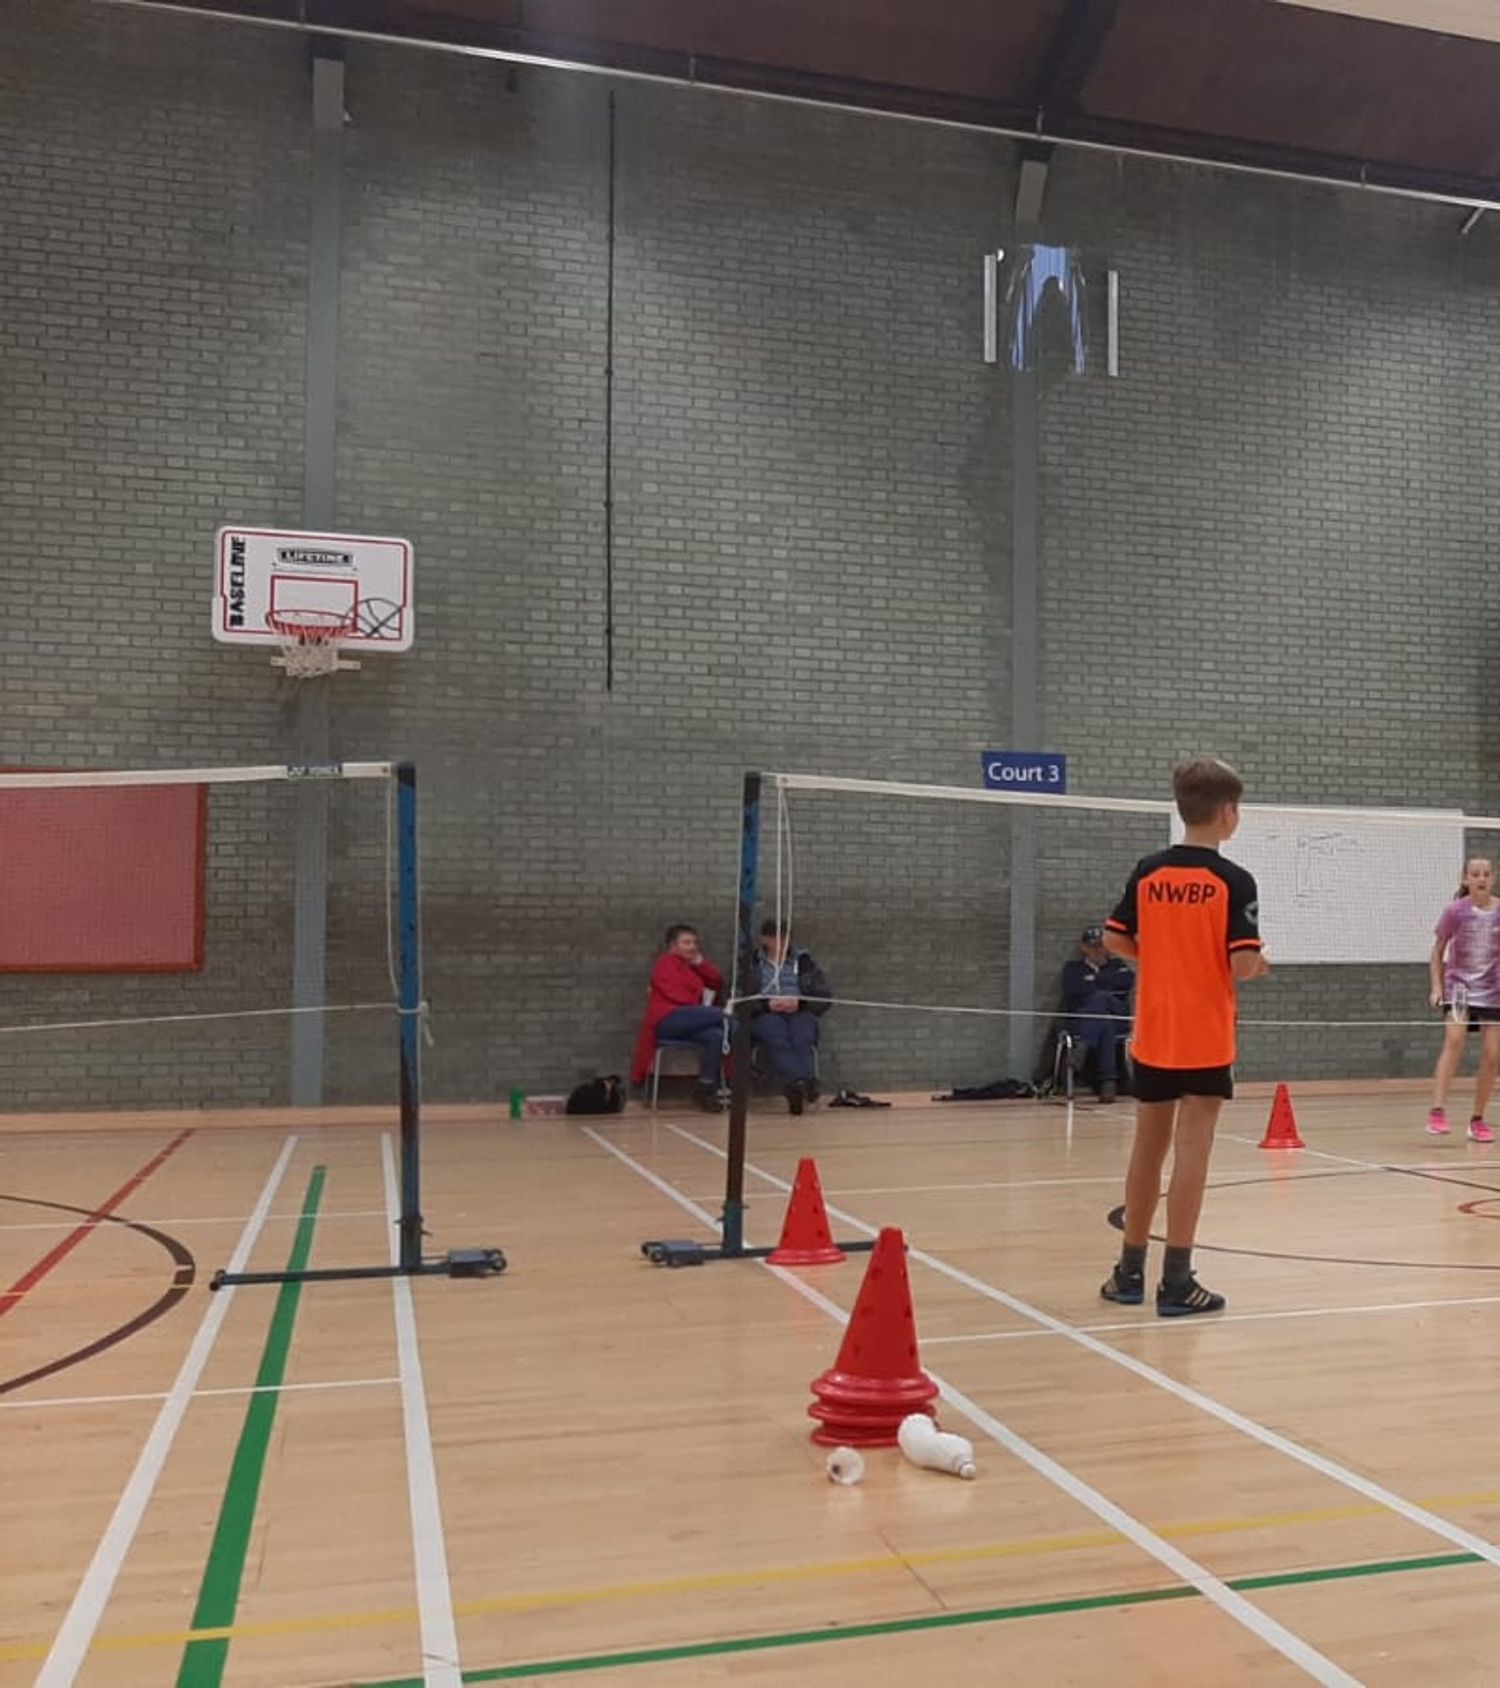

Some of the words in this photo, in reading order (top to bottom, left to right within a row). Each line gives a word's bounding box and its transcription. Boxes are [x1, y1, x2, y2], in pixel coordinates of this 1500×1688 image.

[230, 536, 246, 627] BASELINE
[988, 762, 1042, 782] Court
[1047, 764, 1060, 783] 3
[1148, 881, 1217, 904] NWBP
